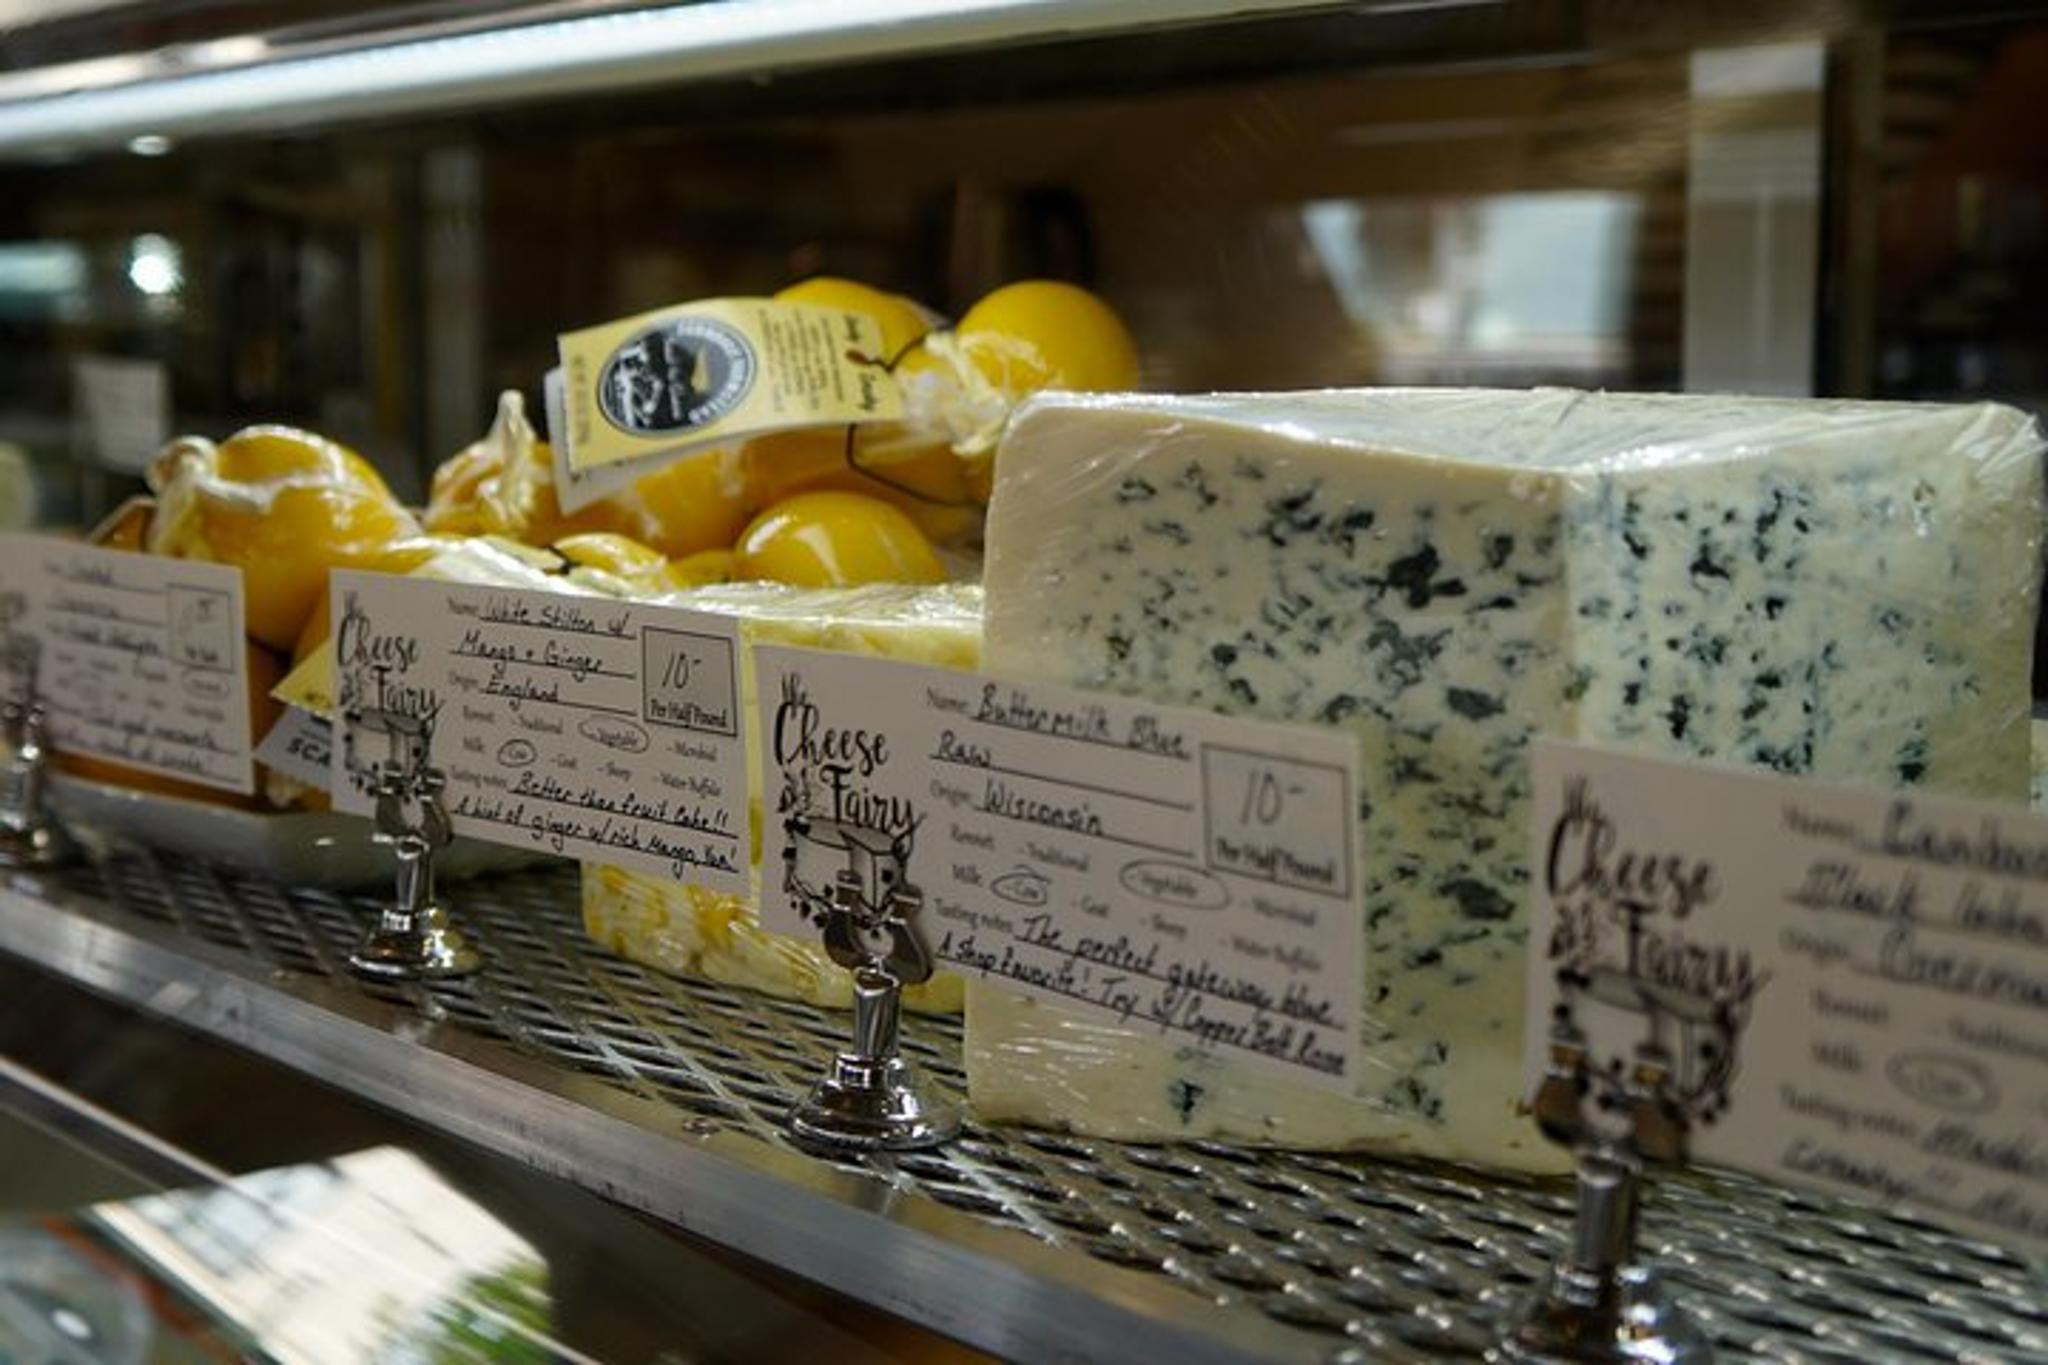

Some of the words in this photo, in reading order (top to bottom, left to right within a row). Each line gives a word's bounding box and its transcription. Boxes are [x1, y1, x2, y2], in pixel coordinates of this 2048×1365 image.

[338, 613, 419, 673] Cheese
[460, 629, 517, 675] Mango
[543, 639, 603, 683] Ginger
[371, 664, 446, 722] Fairy
[483, 669, 561, 710] England
[693, 704, 727, 729] Pound
[774, 702, 889, 777] Cheese
[936, 729, 992, 768] Raw
[517, 771, 572, 801] Better
[819, 764, 927, 845] Fairy
[984, 777, 1104, 838] Wisconsin
[532, 811, 582, 850] ginger
[1217, 837, 1241, 861] Per
[1245, 844, 1278, 881] Half
[1279, 849, 1336, 884] Pound
[1546, 814, 1715, 920] Cheese
[1023, 914, 1063, 949] The
[1076, 935, 1160, 977] perfect
[1163, 961, 1273, 1011] gateway
[1609, 899, 1773, 1015] Fairy
[1101, 975, 1142, 1024] Try
